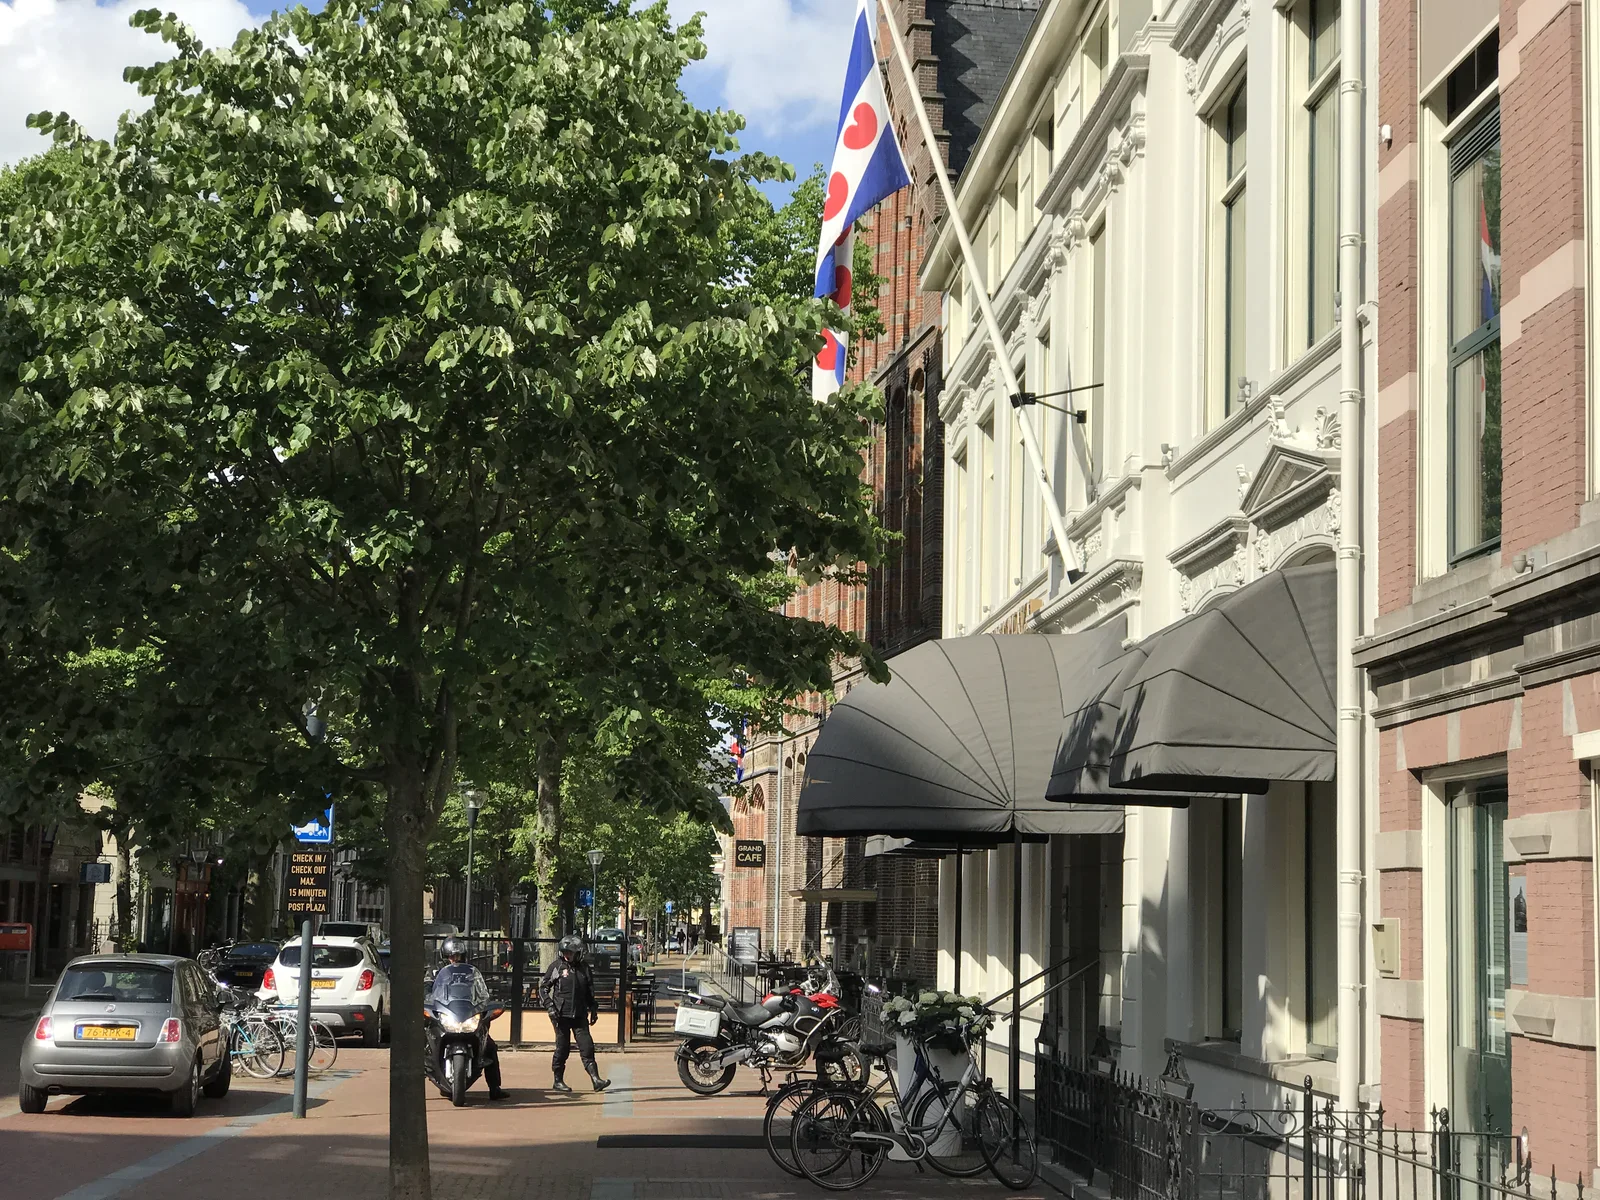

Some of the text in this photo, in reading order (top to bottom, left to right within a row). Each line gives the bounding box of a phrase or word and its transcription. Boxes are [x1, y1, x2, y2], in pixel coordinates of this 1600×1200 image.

[292, 854, 313, 863] CHECK
[314, 854, 323, 863] IN
[737, 853, 762, 862] CAFE
[291, 865, 327, 874] CHECK OUT
[300, 877, 316, 886] MAX.
[289, 888, 327, 897] 15 MINUTEN
[288, 902, 326, 912] POST PLAZA
[86, 1028, 131, 1037] 76-RPK-4
